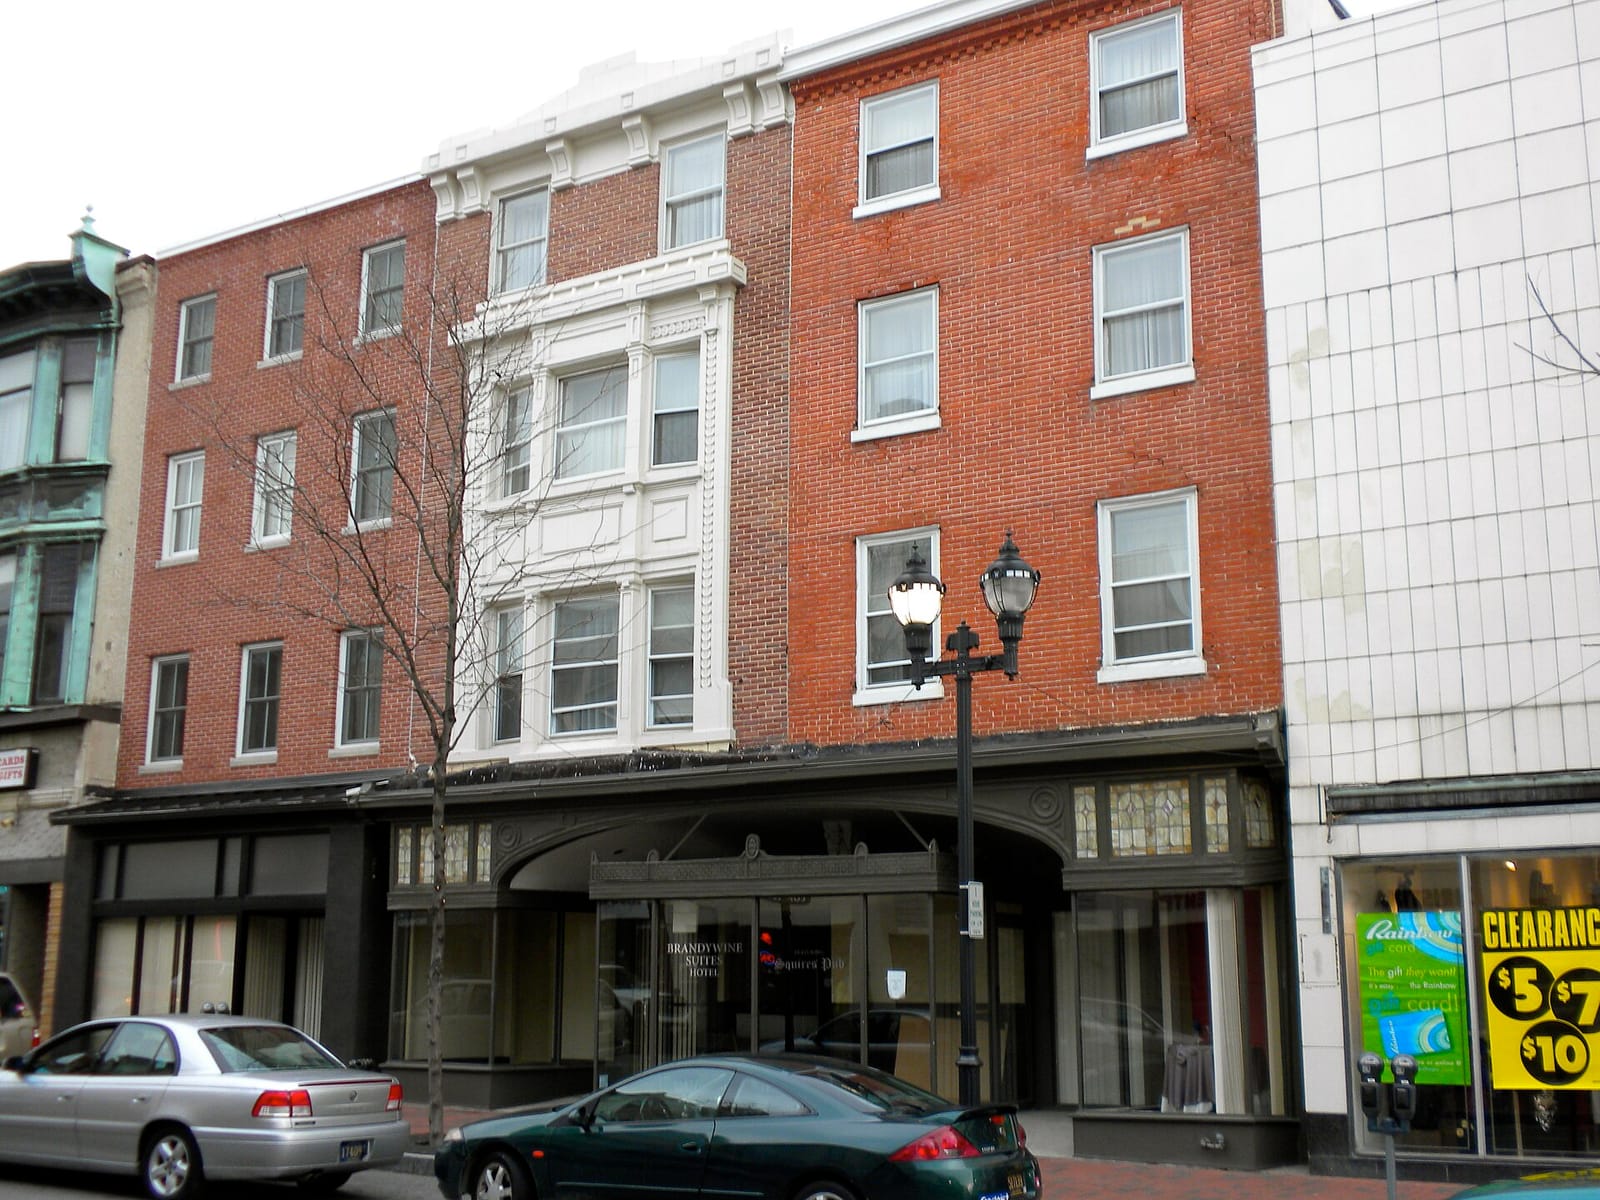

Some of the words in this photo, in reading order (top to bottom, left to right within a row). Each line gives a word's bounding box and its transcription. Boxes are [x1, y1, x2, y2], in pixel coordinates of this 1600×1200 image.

[1366, 919, 1453, 940] Rainbow
[667, 942, 743, 954] BRANDYWINE
[685, 955, 722, 966] SUITES
[821, 957, 845, 972] Pub
[689, 967, 719, 977] HOTEL
[1368, 967, 1385, 977] The
[1387, 966, 1403, 979] gift
[1405, 966, 1426, 978] they
[1498, 967, 1543, 1013] $5
[1407, 991, 1459, 1013] card!
[1556, 980, 1600, 1026] $7
[1522, 1034, 1587, 1073] $10
